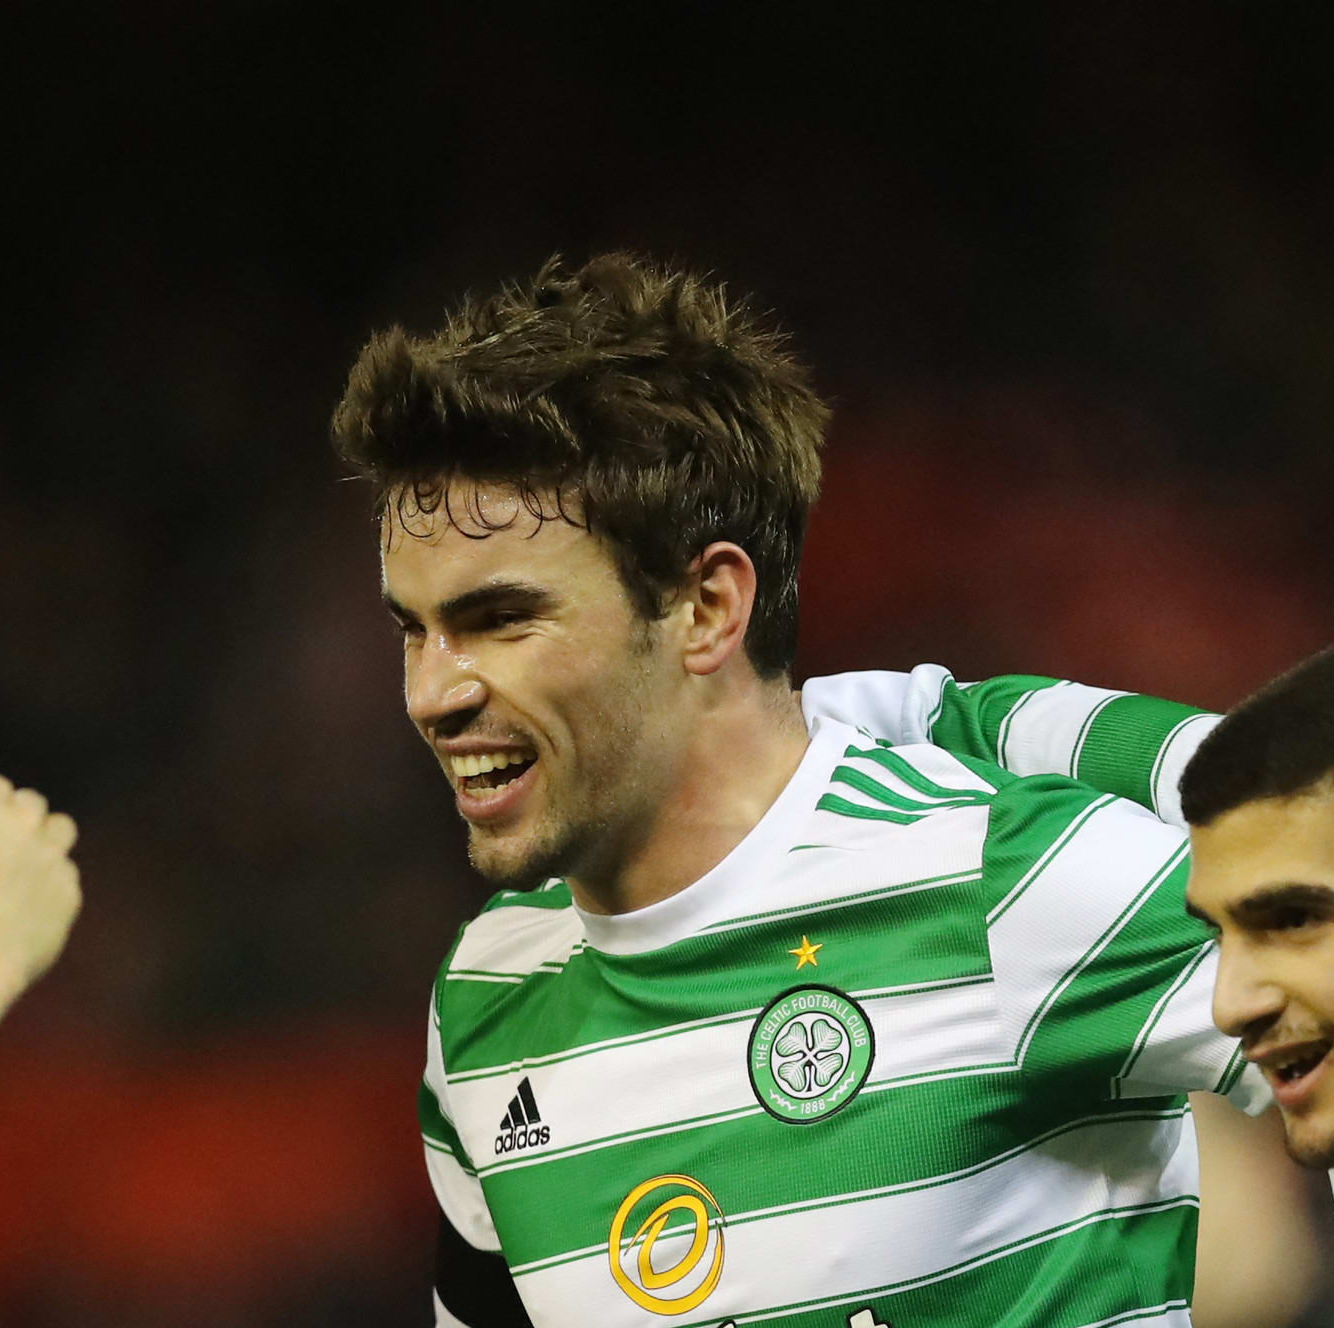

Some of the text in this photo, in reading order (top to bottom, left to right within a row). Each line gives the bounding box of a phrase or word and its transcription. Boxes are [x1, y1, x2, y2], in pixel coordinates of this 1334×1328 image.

[755, 994, 867, 1070] THE CELTIC FOOTBALL CLUB
[800, 1098, 826, 1115] 1888
[494, 1124, 551, 1155] adidas
